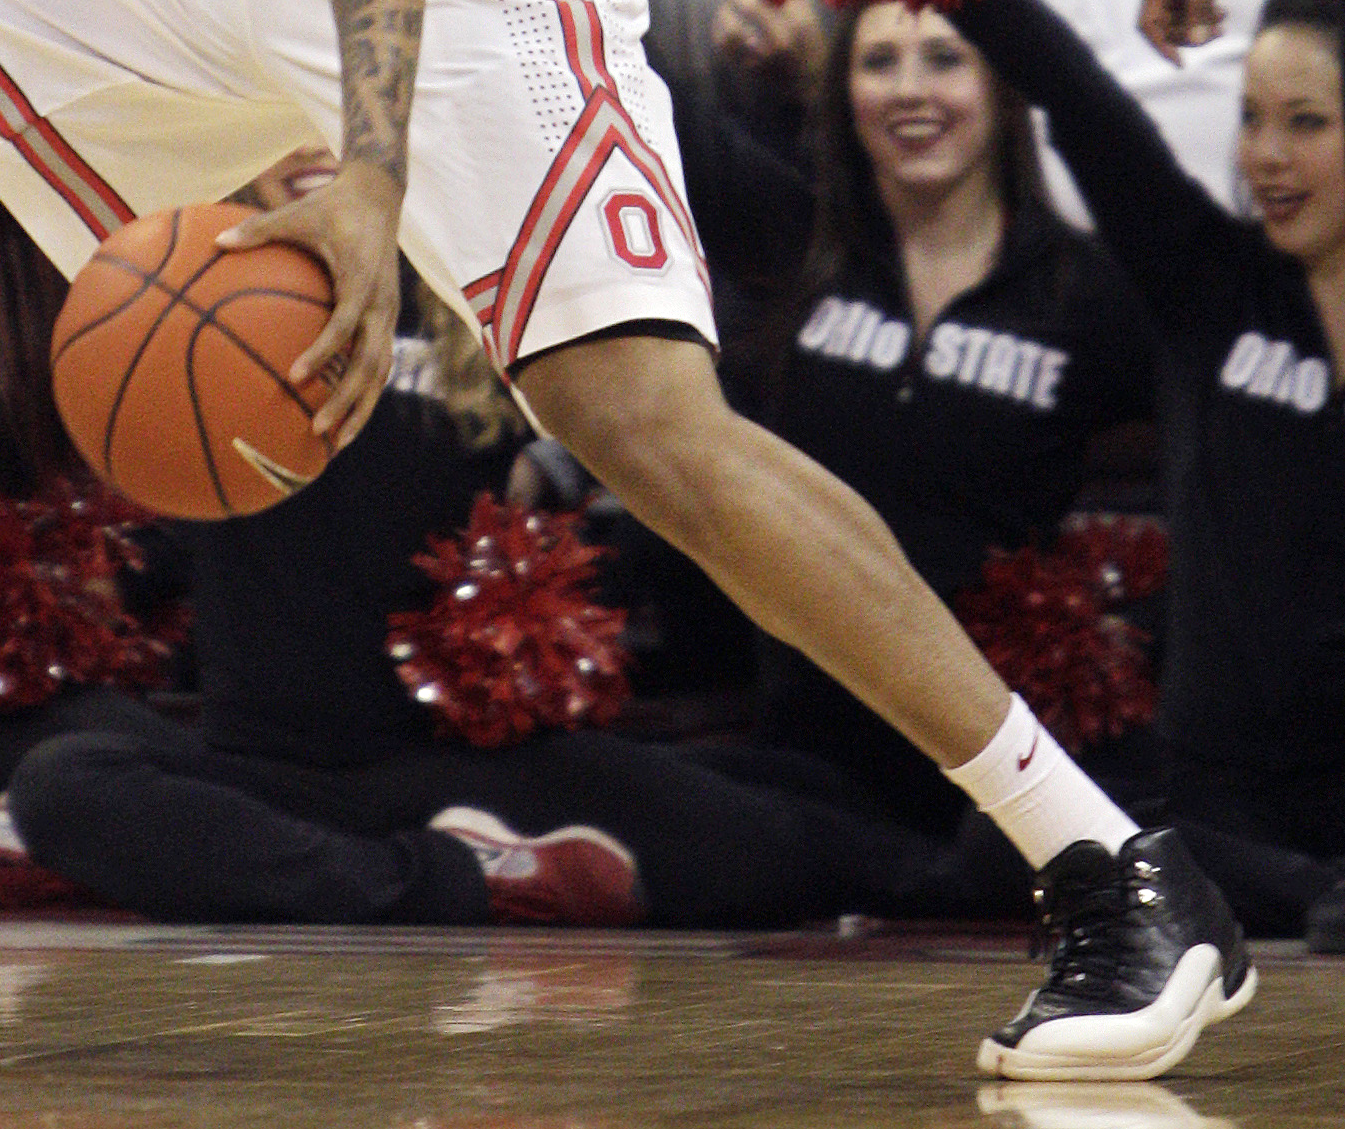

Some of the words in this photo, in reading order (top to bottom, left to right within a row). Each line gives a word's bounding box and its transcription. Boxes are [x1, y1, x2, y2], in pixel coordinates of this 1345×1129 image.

[600, 190, 673, 275] O
[798, 295, 911, 369] OHIO
[924, 321, 1069, 409] STATE
